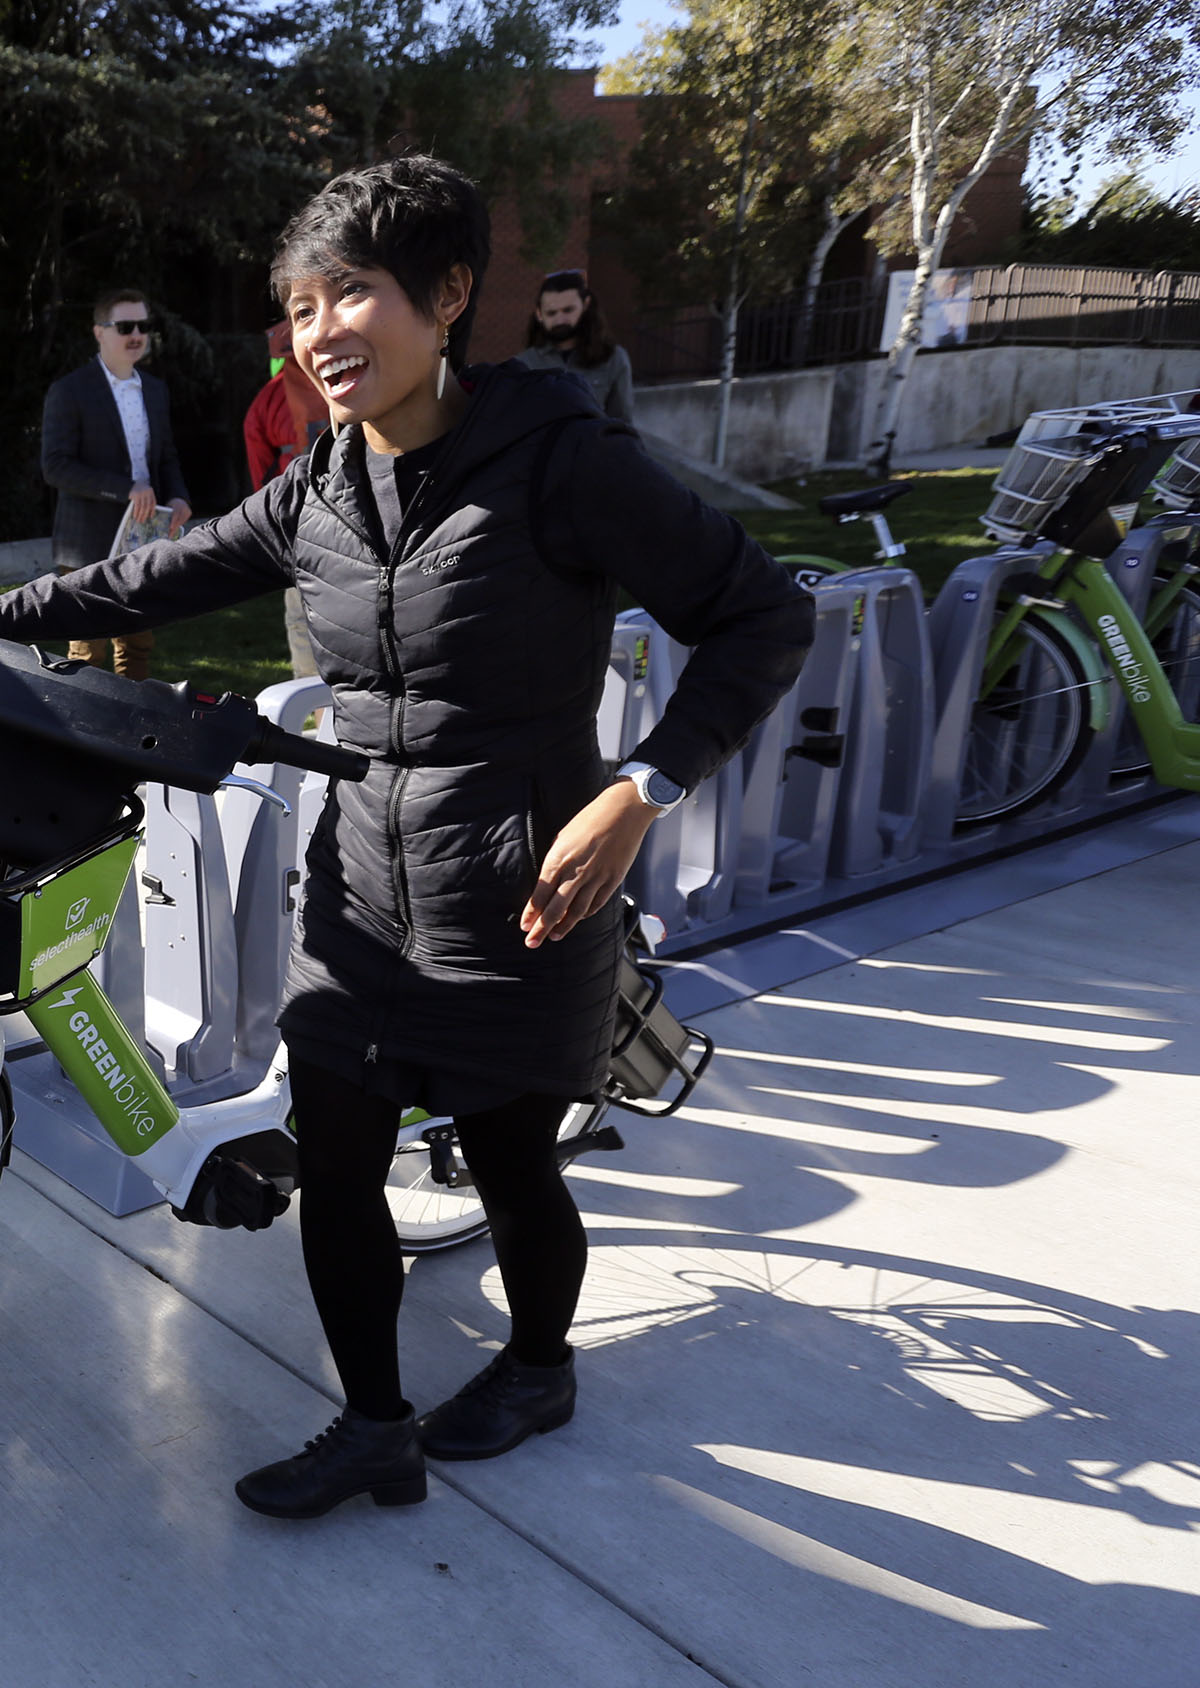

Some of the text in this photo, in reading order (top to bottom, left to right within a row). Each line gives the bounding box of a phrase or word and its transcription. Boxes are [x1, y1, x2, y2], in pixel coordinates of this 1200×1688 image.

[1097, 614, 1152, 704] GREENbike
[29, 912, 109, 971] selecthealth
[69, 1011, 155, 1136] GREENbike
